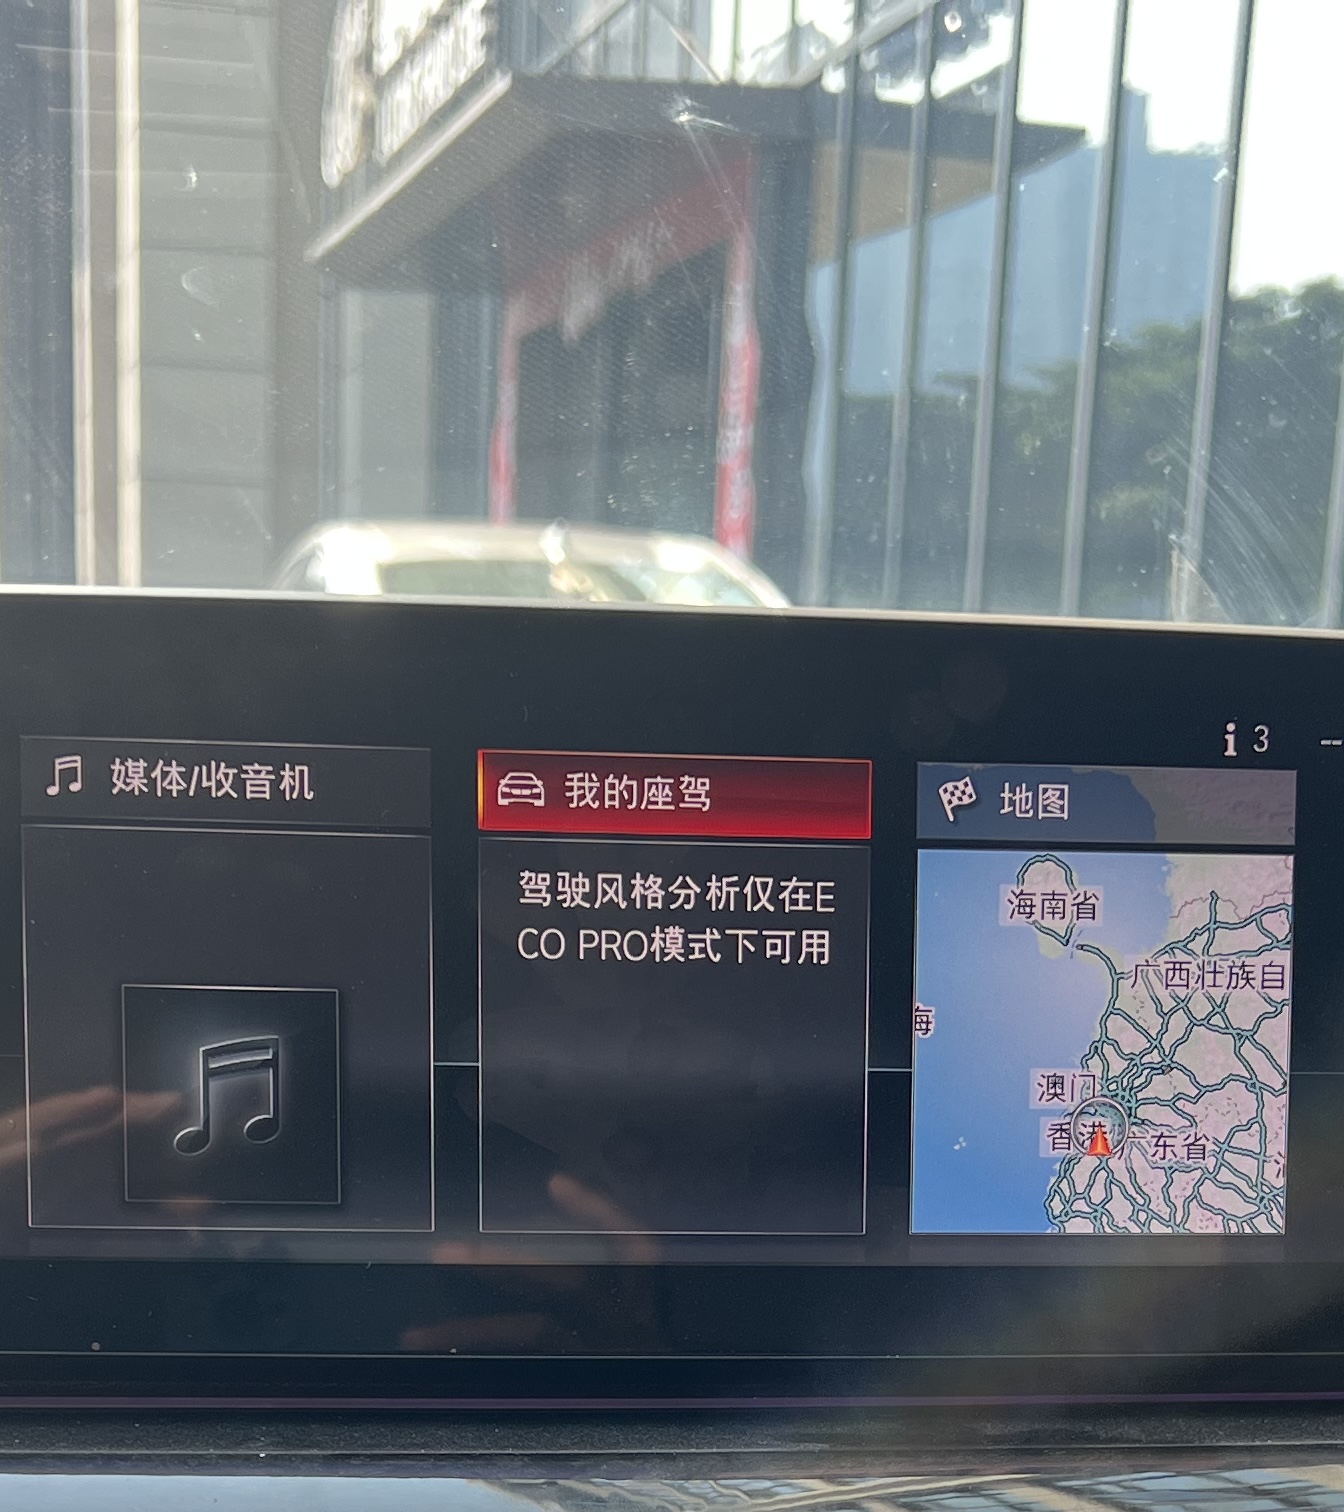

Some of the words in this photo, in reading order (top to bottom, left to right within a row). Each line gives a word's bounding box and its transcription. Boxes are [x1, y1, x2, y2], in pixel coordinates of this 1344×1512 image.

[1253, 725, 1269, 752] 3
[110, 757, 314, 801] 媒体/收音机
[564, 772, 711, 811] 我的座驾
[999, 783, 1070, 820] 地图
[519, 870, 836, 913] 驾驶风格分析仅在E
[1007, 890, 1100, 922] 海南省
[1131, 960, 1286, 991] 广西壮族自
[1037, 1073, 1096, 1103] 澳门
[1047, 1121, 1108, 1152] 香港
